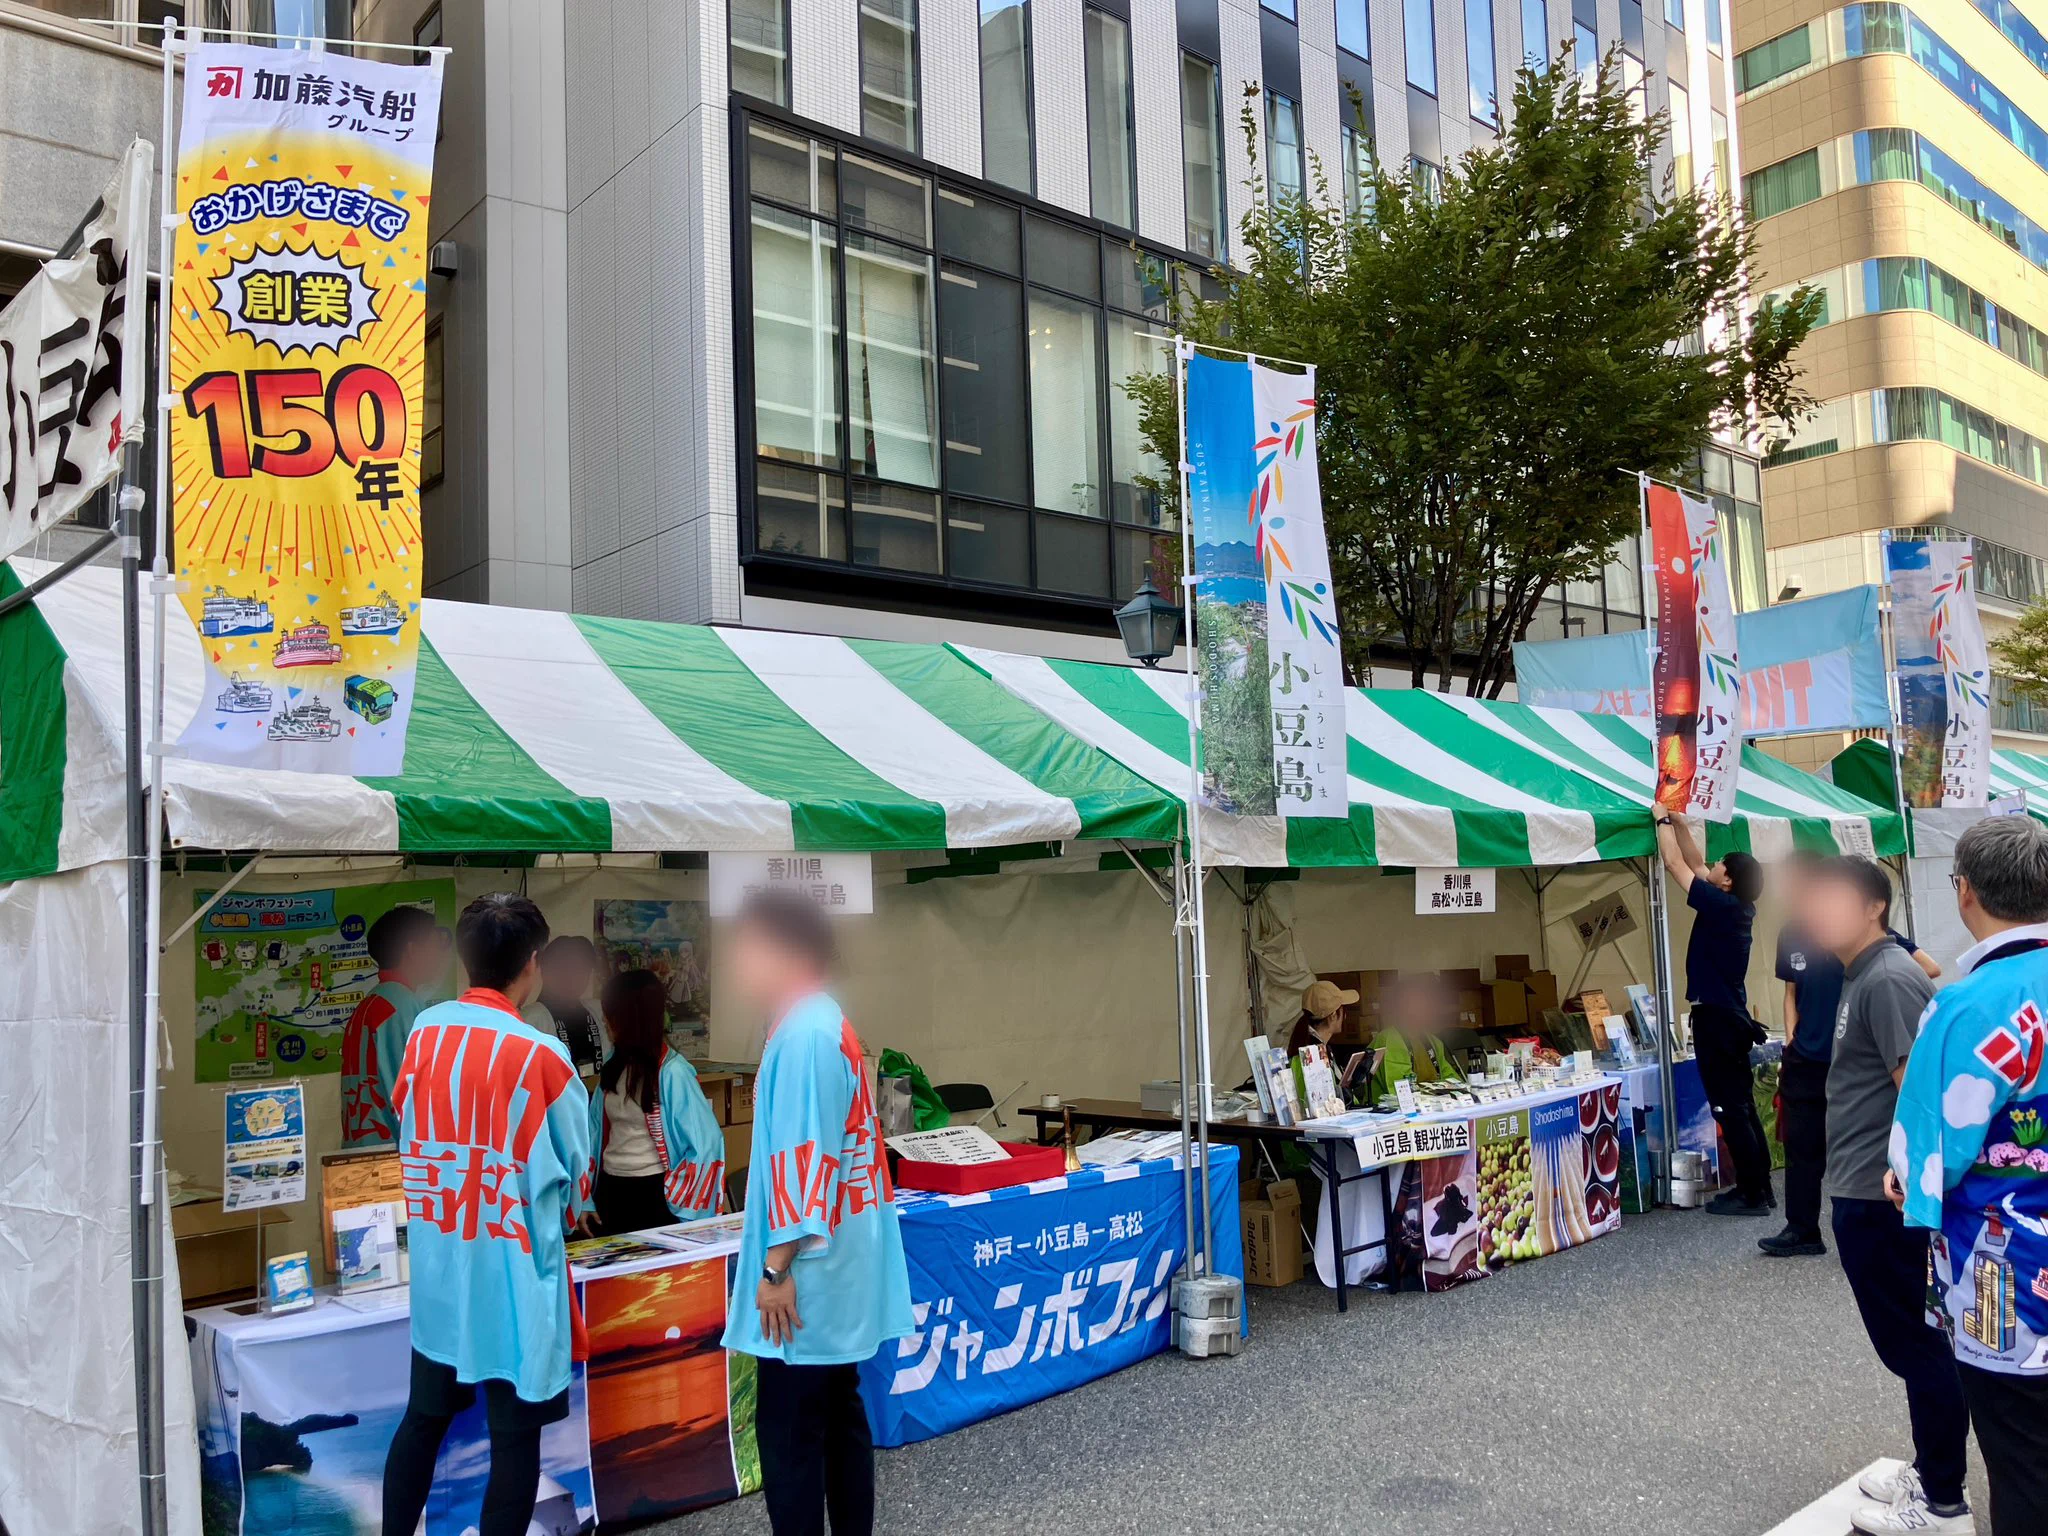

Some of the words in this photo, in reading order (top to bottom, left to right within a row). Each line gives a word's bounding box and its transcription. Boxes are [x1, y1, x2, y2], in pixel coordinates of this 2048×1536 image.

[253, 68, 417, 122] 加藤汽船
[327, 113, 414, 142] グループ
[190, 179, 408, 240] おかげさまで
[243, 272, 351, 326] 創業
[1195, 443, 1214, 542] SUSTAINABLE
[1205, 552, 1216, 609] ISLAND
[1659, 547, 1671, 624] SUSTAINABLE
[1207, 620, 1221, 724] SHODOSHIMA
[1660, 631, 1671, 673] ISLAND
[1269, 652, 1313, 803] 小豆島
[1313, 663, 1328, 799] しょうどしま
[1943, 712, 1969, 800] 小豆島
[1690, 705, 1728, 810] 小豆島
[767, 858, 824, 881] 香川県
[1443, 874, 1472, 890] 香川県
[1431, 891, 1483, 908] 高松・小豆島
[1486, 1118, 1520, 1140] 小豆島
[1535, 1105, 1574, 1127] Shodoshima
[400, 1140, 532, 1254] 高松
